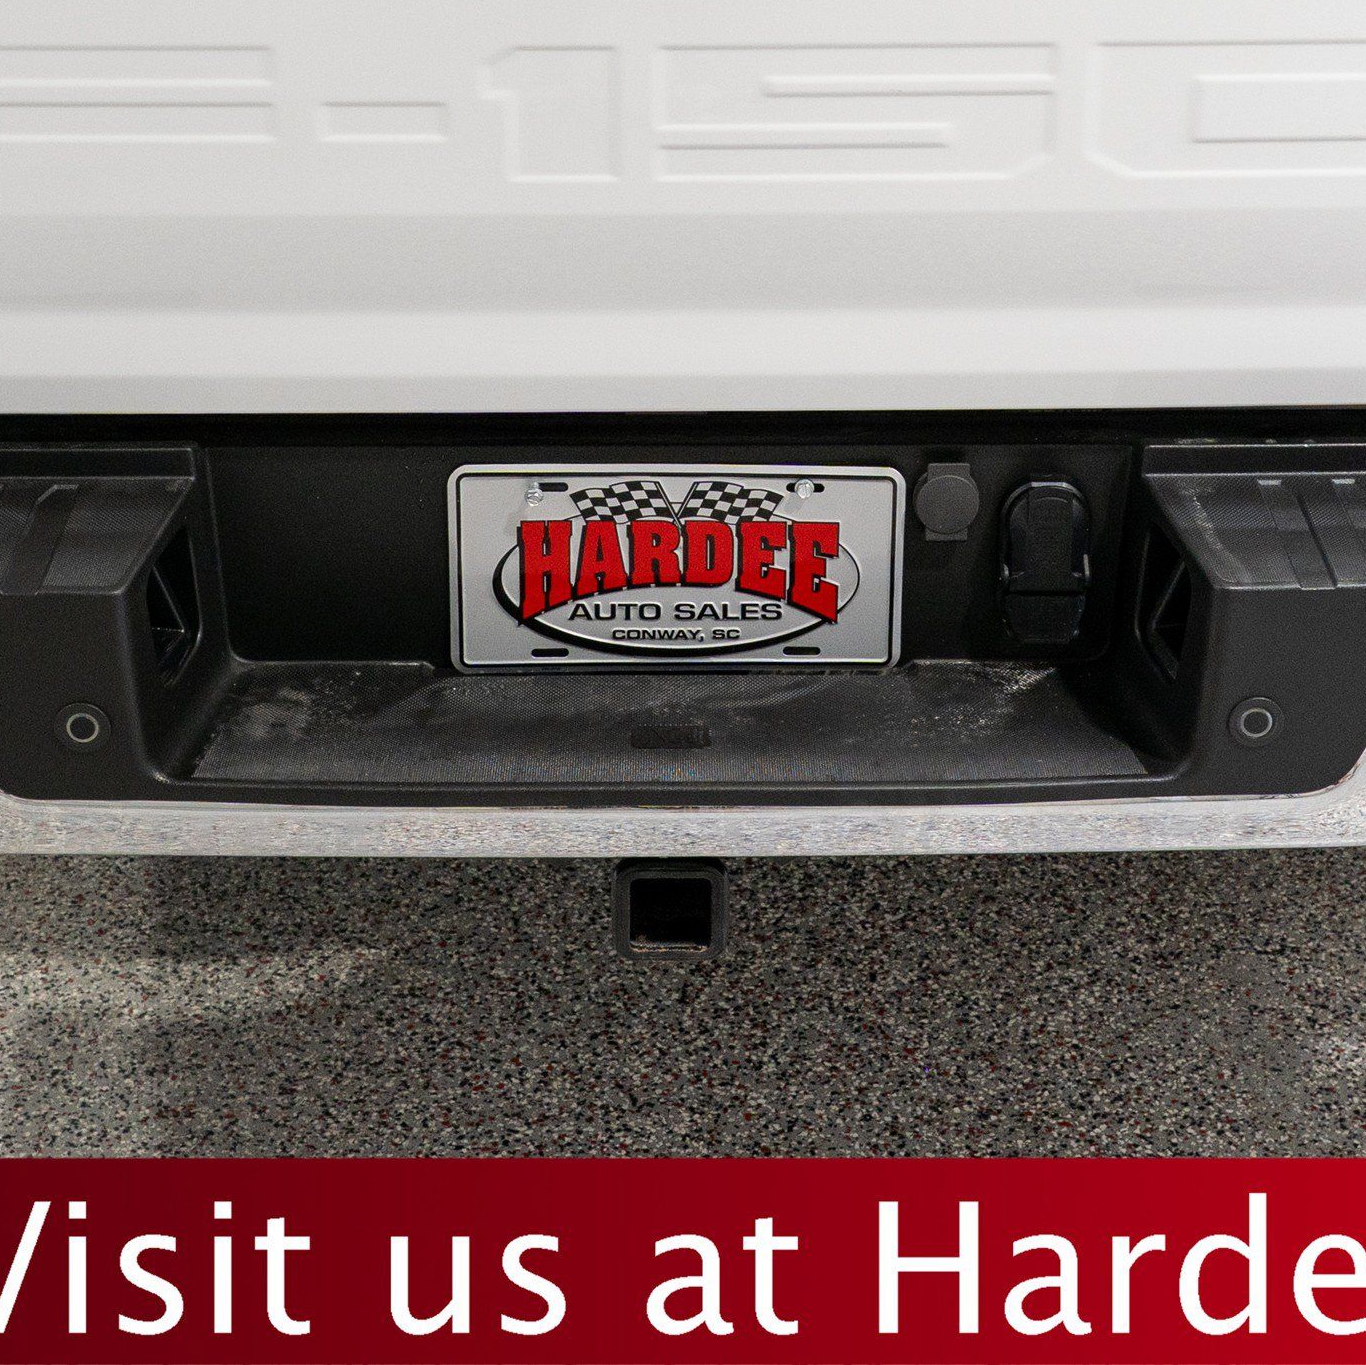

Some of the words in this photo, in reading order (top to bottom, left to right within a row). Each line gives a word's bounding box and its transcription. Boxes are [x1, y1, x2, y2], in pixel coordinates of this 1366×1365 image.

[517, 520, 840, 625] HARDEE
[568, 601, 662, 622] AUTO
[673, 601, 783, 622] SALES
[611, 627, 705, 642] CONWAY,
[712, 627, 741, 640] SC
